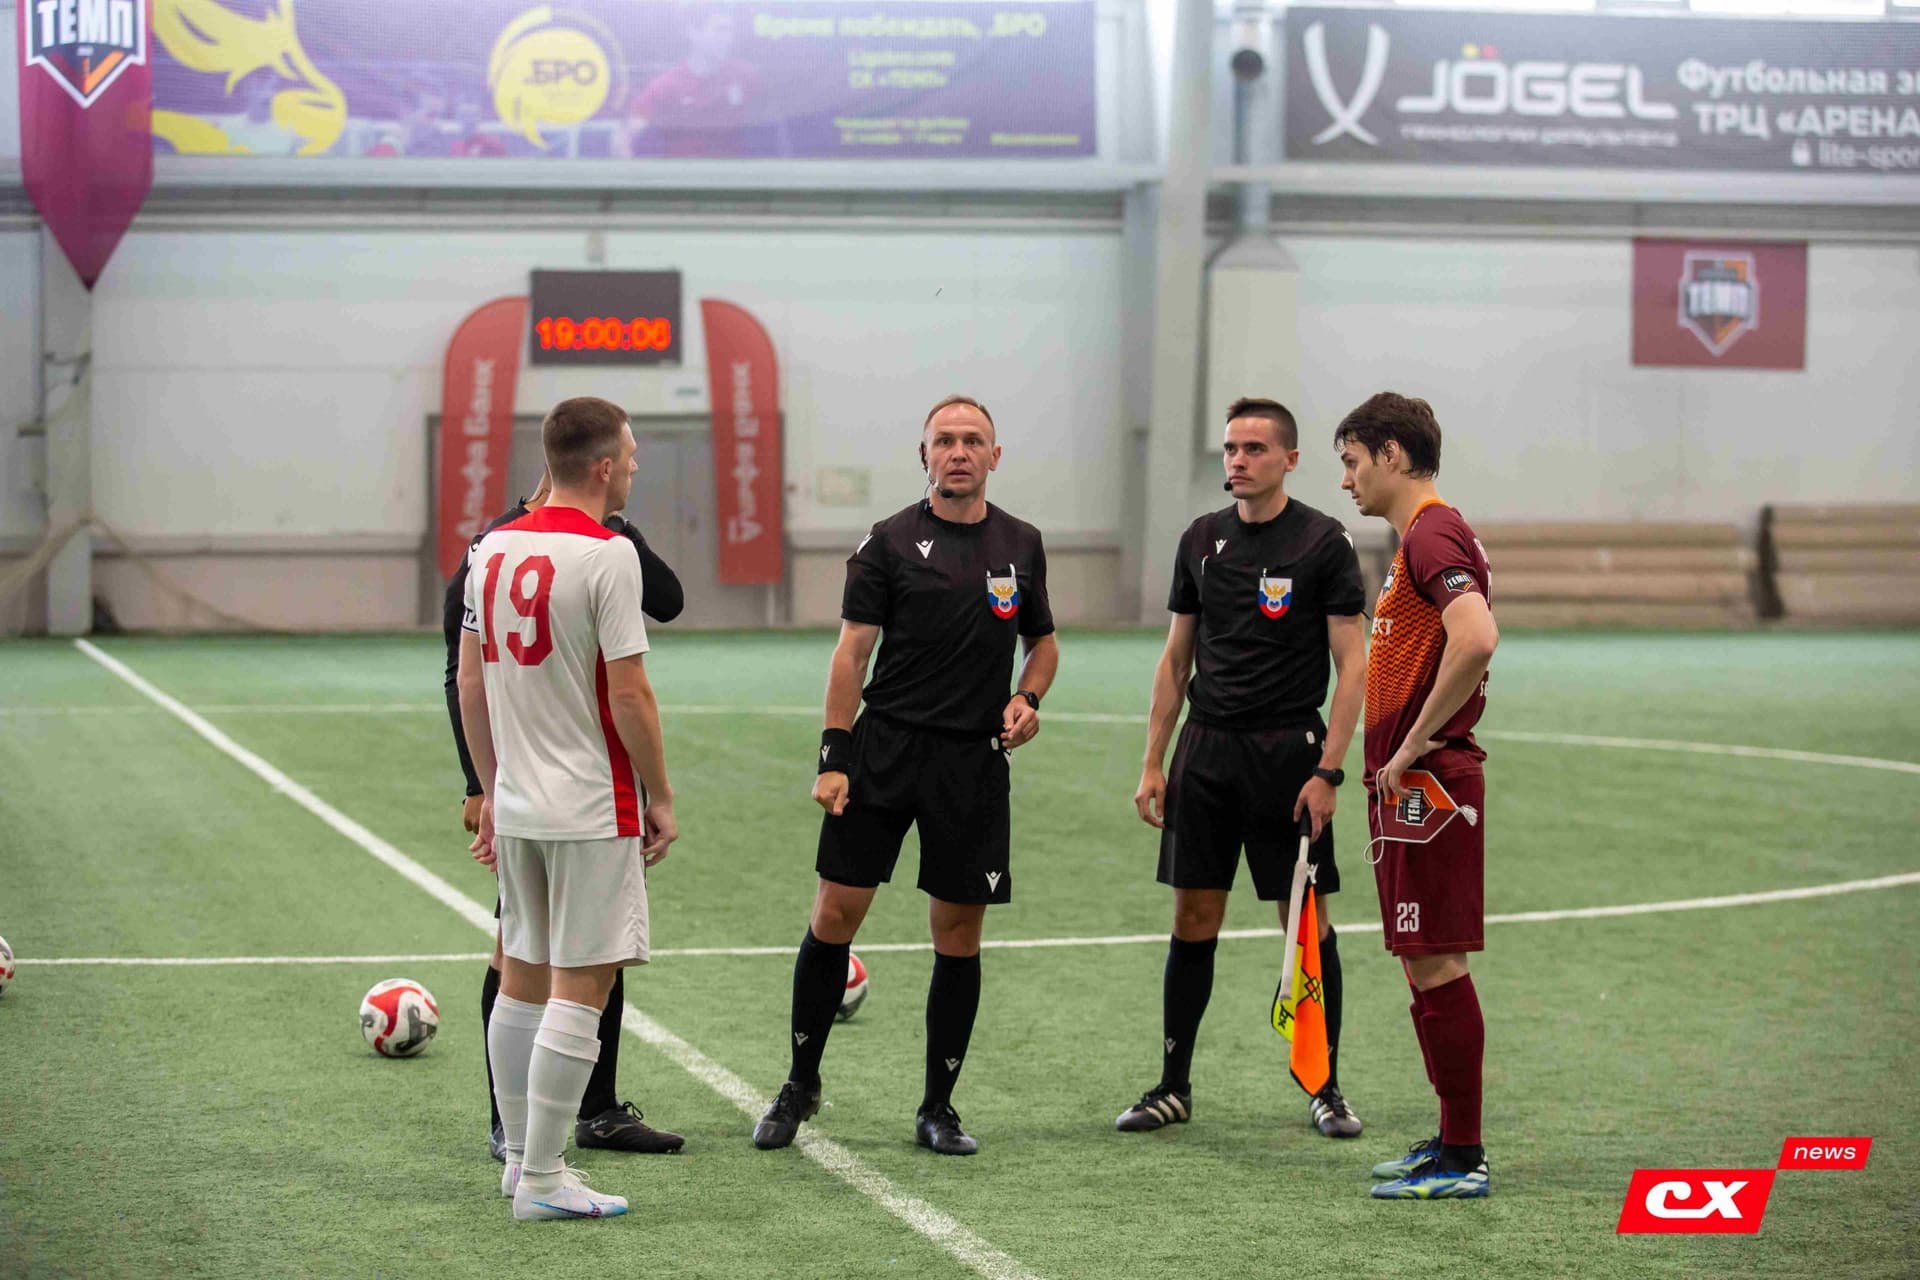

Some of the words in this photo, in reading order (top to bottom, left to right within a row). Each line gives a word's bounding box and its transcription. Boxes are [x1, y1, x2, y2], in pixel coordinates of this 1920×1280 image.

[38, 0, 133, 48] ТЕМП
[1396, 44, 1678, 120] JÖGEL
[1676, 57, 1887, 99] Футбольная
[1692, 104, 1772, 140] ТРЦ
[481, 552, 556, 666] 19
[1397, 902, 1420, 933] 23
